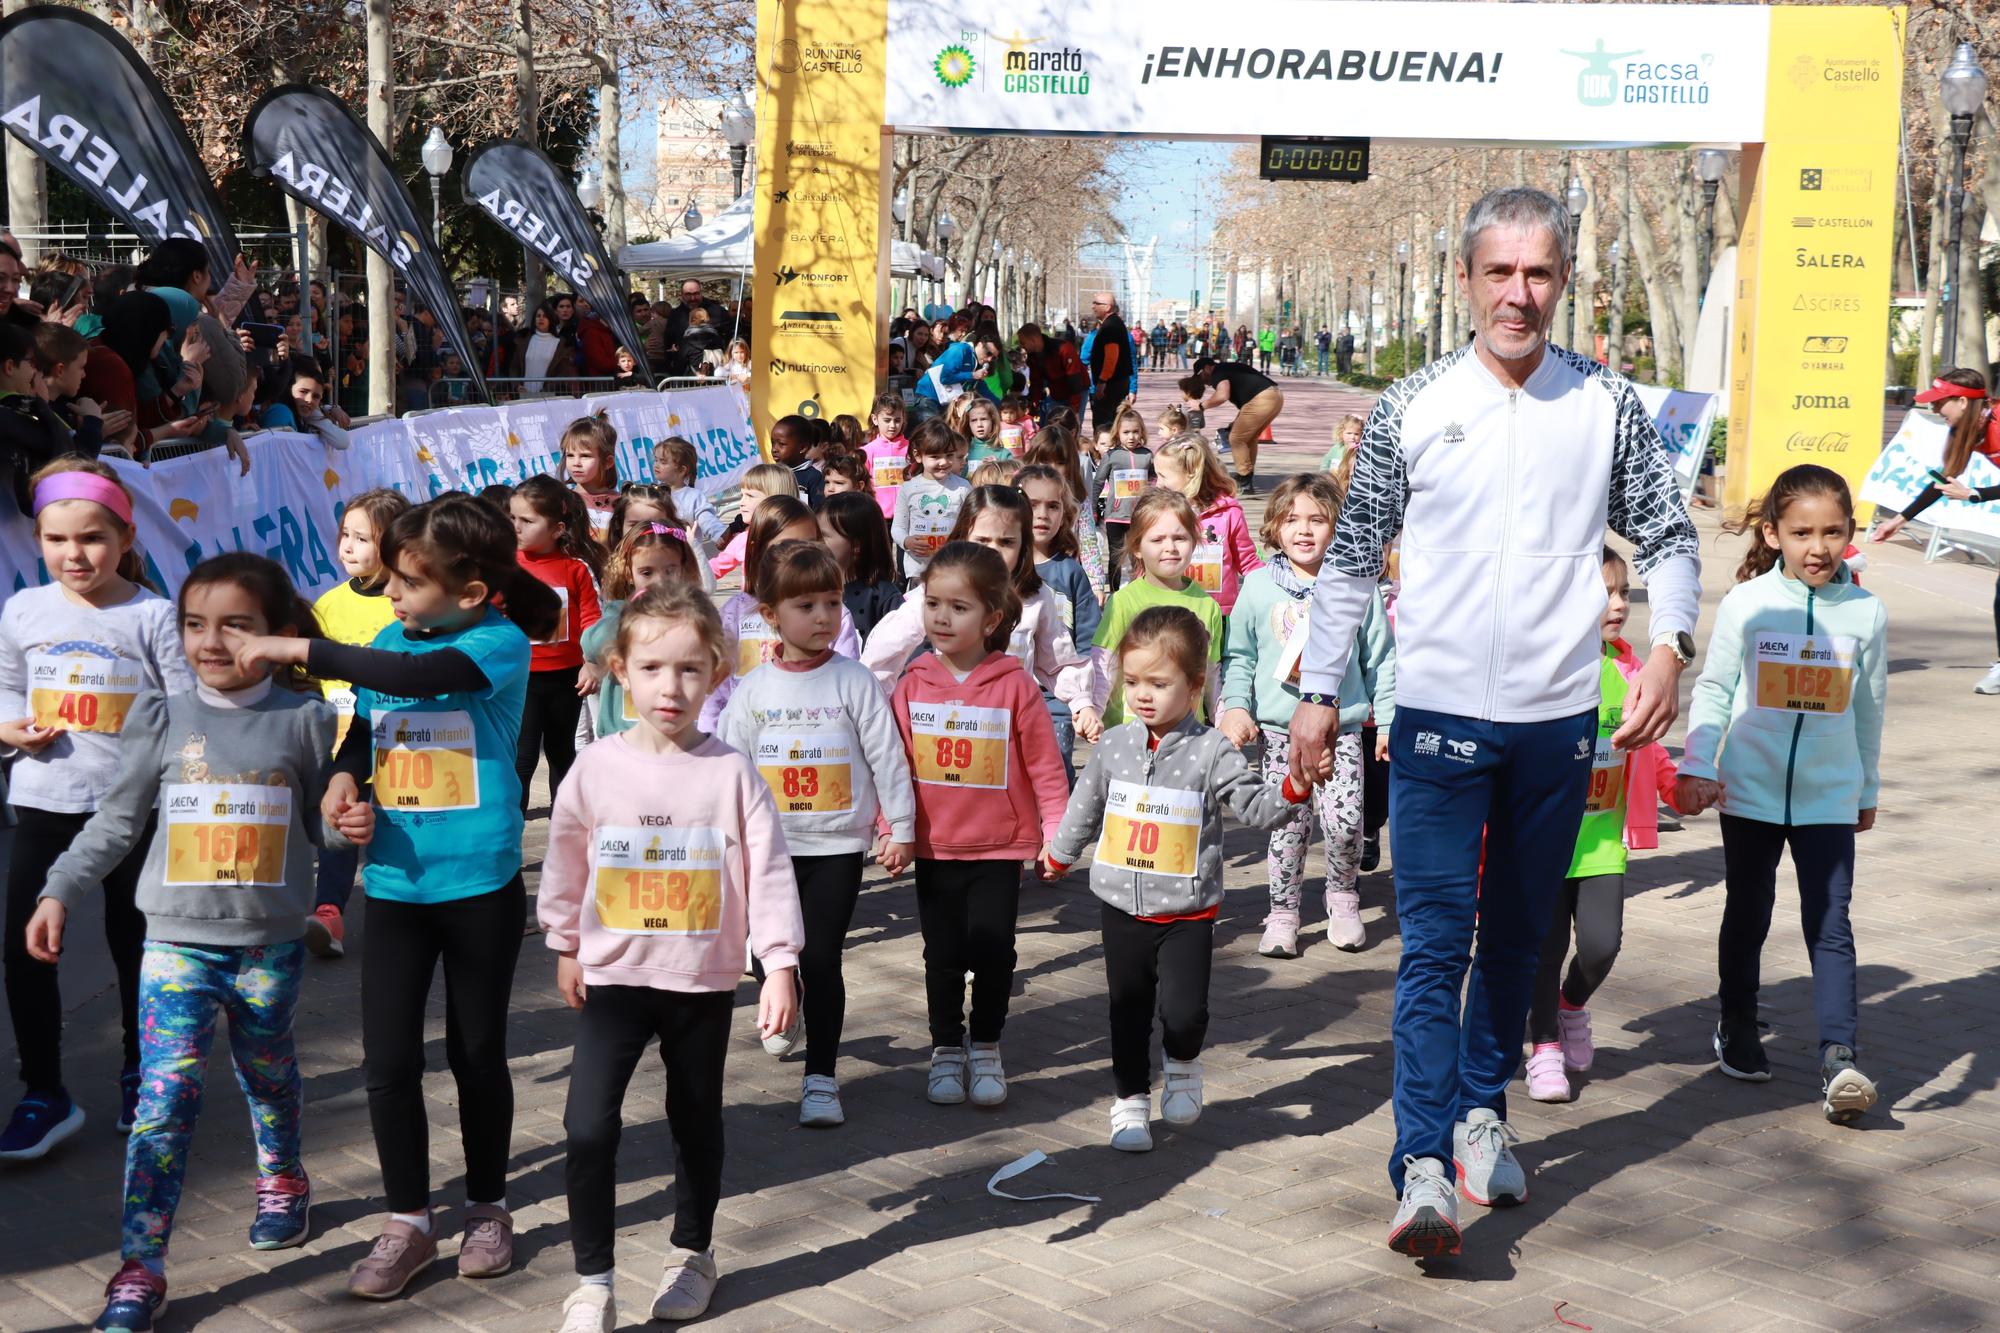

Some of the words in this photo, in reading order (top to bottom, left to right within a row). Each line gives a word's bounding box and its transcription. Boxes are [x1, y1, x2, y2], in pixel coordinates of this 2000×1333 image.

[961, 29, 978, 43] bp
[805, 48, 862, 60] RUNNING
[1006, 48, 1082, 72] marató
[804, 59, 863, 73] CASTELLÓ
[1141, 46, 1503, 84] ¡ENHORABUENA!
[1823, 67, 1880, 81] Castelló
[1004, 72, 1090, 95] CASTELLÓ
[1624, 82, 1709, 104] CASTELLÓ
[1269, 148, 1362, 171] 0:00:00
[791, 234, 845, 243] BAVIERA
[1796, 253, 1866, 268] SALERA
[801, 273, 849, 282] MONFORT
[788, 362, 847, 374] nutrinovex
[1801, 649, 1831, 661] marató
[70, 673, 105, 686] marató
[1784, 666, 1832, 698] 162
[58, 693, 98, 726] 40
[1787, 700, 1801, 709] ANA
[1803, 701, 1826, 710] CLARA
[946, 720, 978, 731] marató
[396, 728, 431, 742] marató
[790, 747, 822, 759] marató
[936, 737, 972, 769] 89
[388, 752, 433, 790] 170
[945, 773, 960, 782] MAR
[783, 767, 819, 797] 83
[397, 796, 419, 805] ALMA
[214, 802, 256, 815] marató
[1136, 802, 1169, 816] marató
[638, 815, 673, 826] VEGA
[1127, 820, 1159, 855] 70
[645, 846, 687, 861] marató
[1126, 857, 1154, 869] VALERIA
[217, 869, 236, 879] ONA
[624, 871, 689, 912] 153
[643, 918, 668, 928] VEGA
